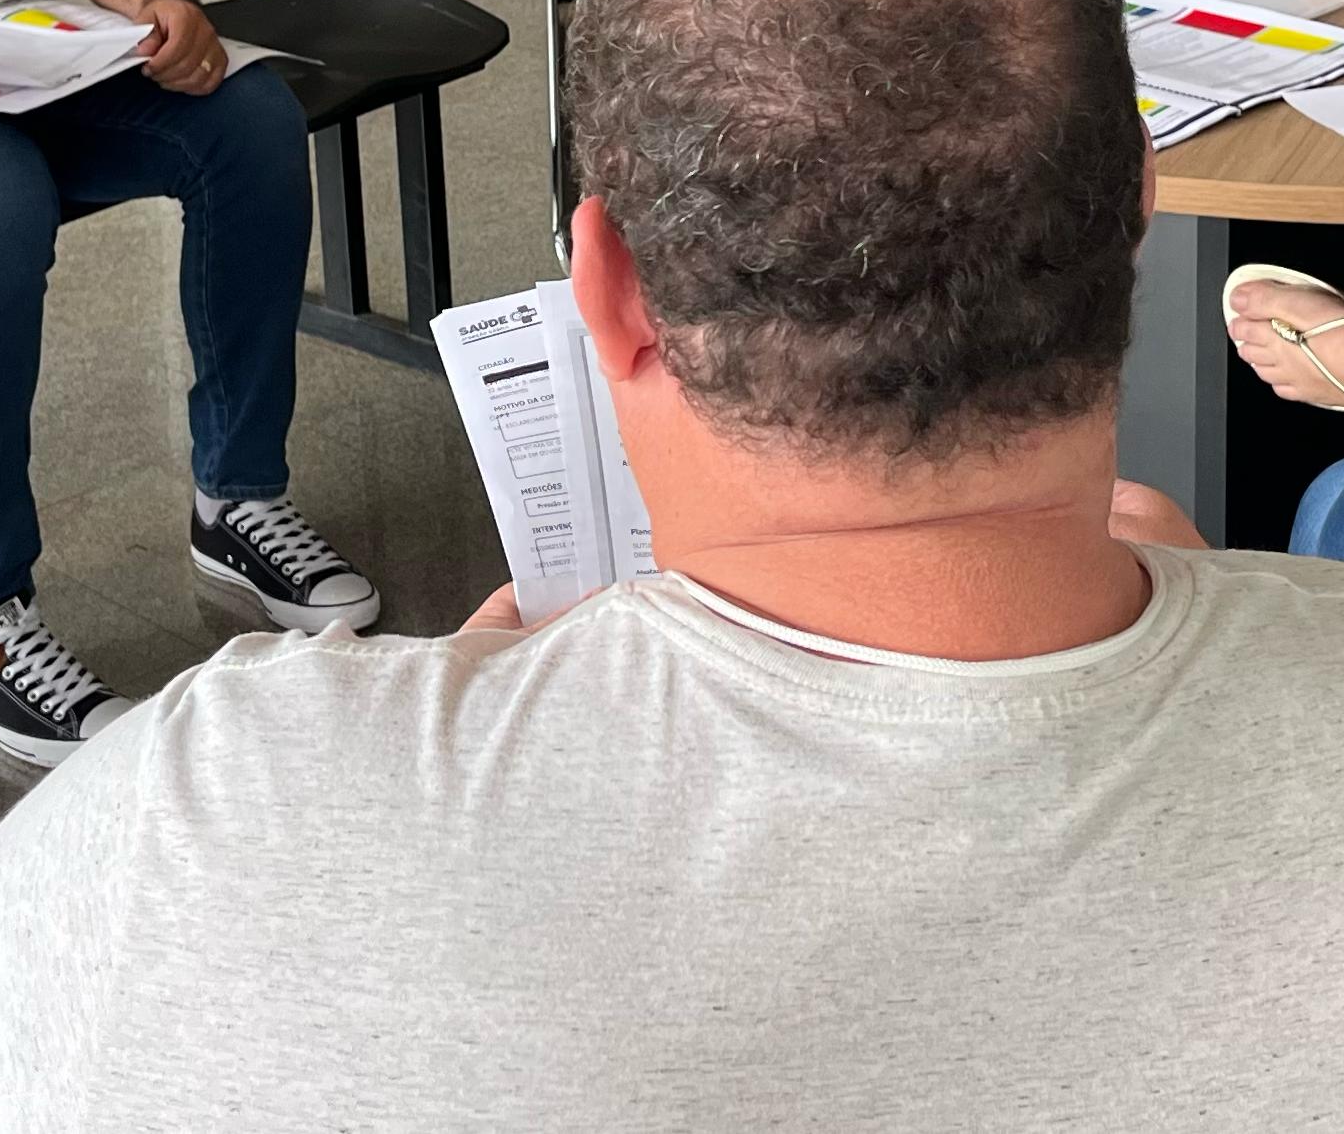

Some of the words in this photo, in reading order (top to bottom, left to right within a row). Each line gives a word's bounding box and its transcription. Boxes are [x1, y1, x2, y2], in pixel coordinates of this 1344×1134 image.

[459, 315, 509, 337] SAÚDE
[478, 356, 515, 371] CIDADÃO
[493, 399, 526, 412] MOTIVO
[527, 396, 539, 405] DA
[520, 482, 563, 496] MEDIÇÕES
